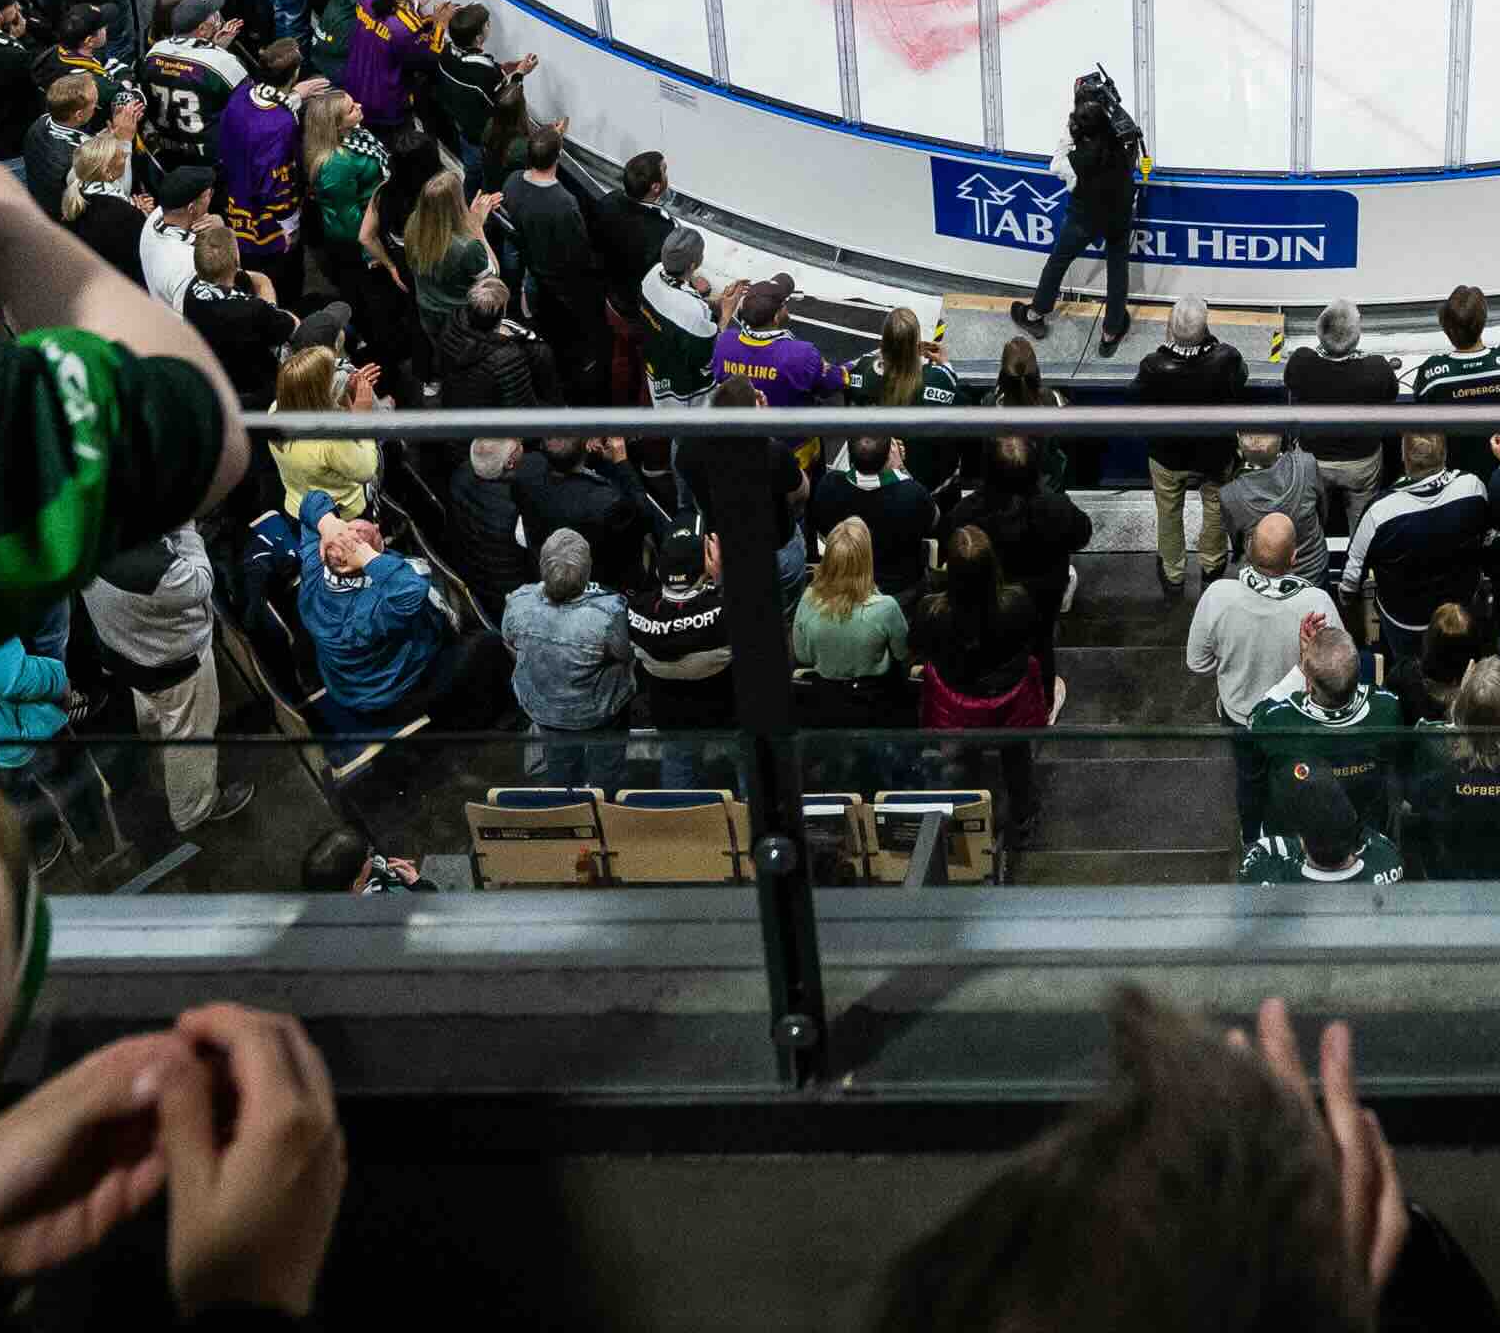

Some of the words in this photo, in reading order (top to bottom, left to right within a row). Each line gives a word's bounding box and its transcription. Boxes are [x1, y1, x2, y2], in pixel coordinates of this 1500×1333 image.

[148, 87, 205, 134] 73
[993, 208, 1055, 245] AB
[1187, 227, 1326, 263] HEDIN
[1425, 362, 1450, 378] elon
[925, 387, 953, 404] elon
[628, 607, 671, 636] PERDRY
[672, 605, 722, 634] SPORT
[1373, 864, 1404, 886] elon
